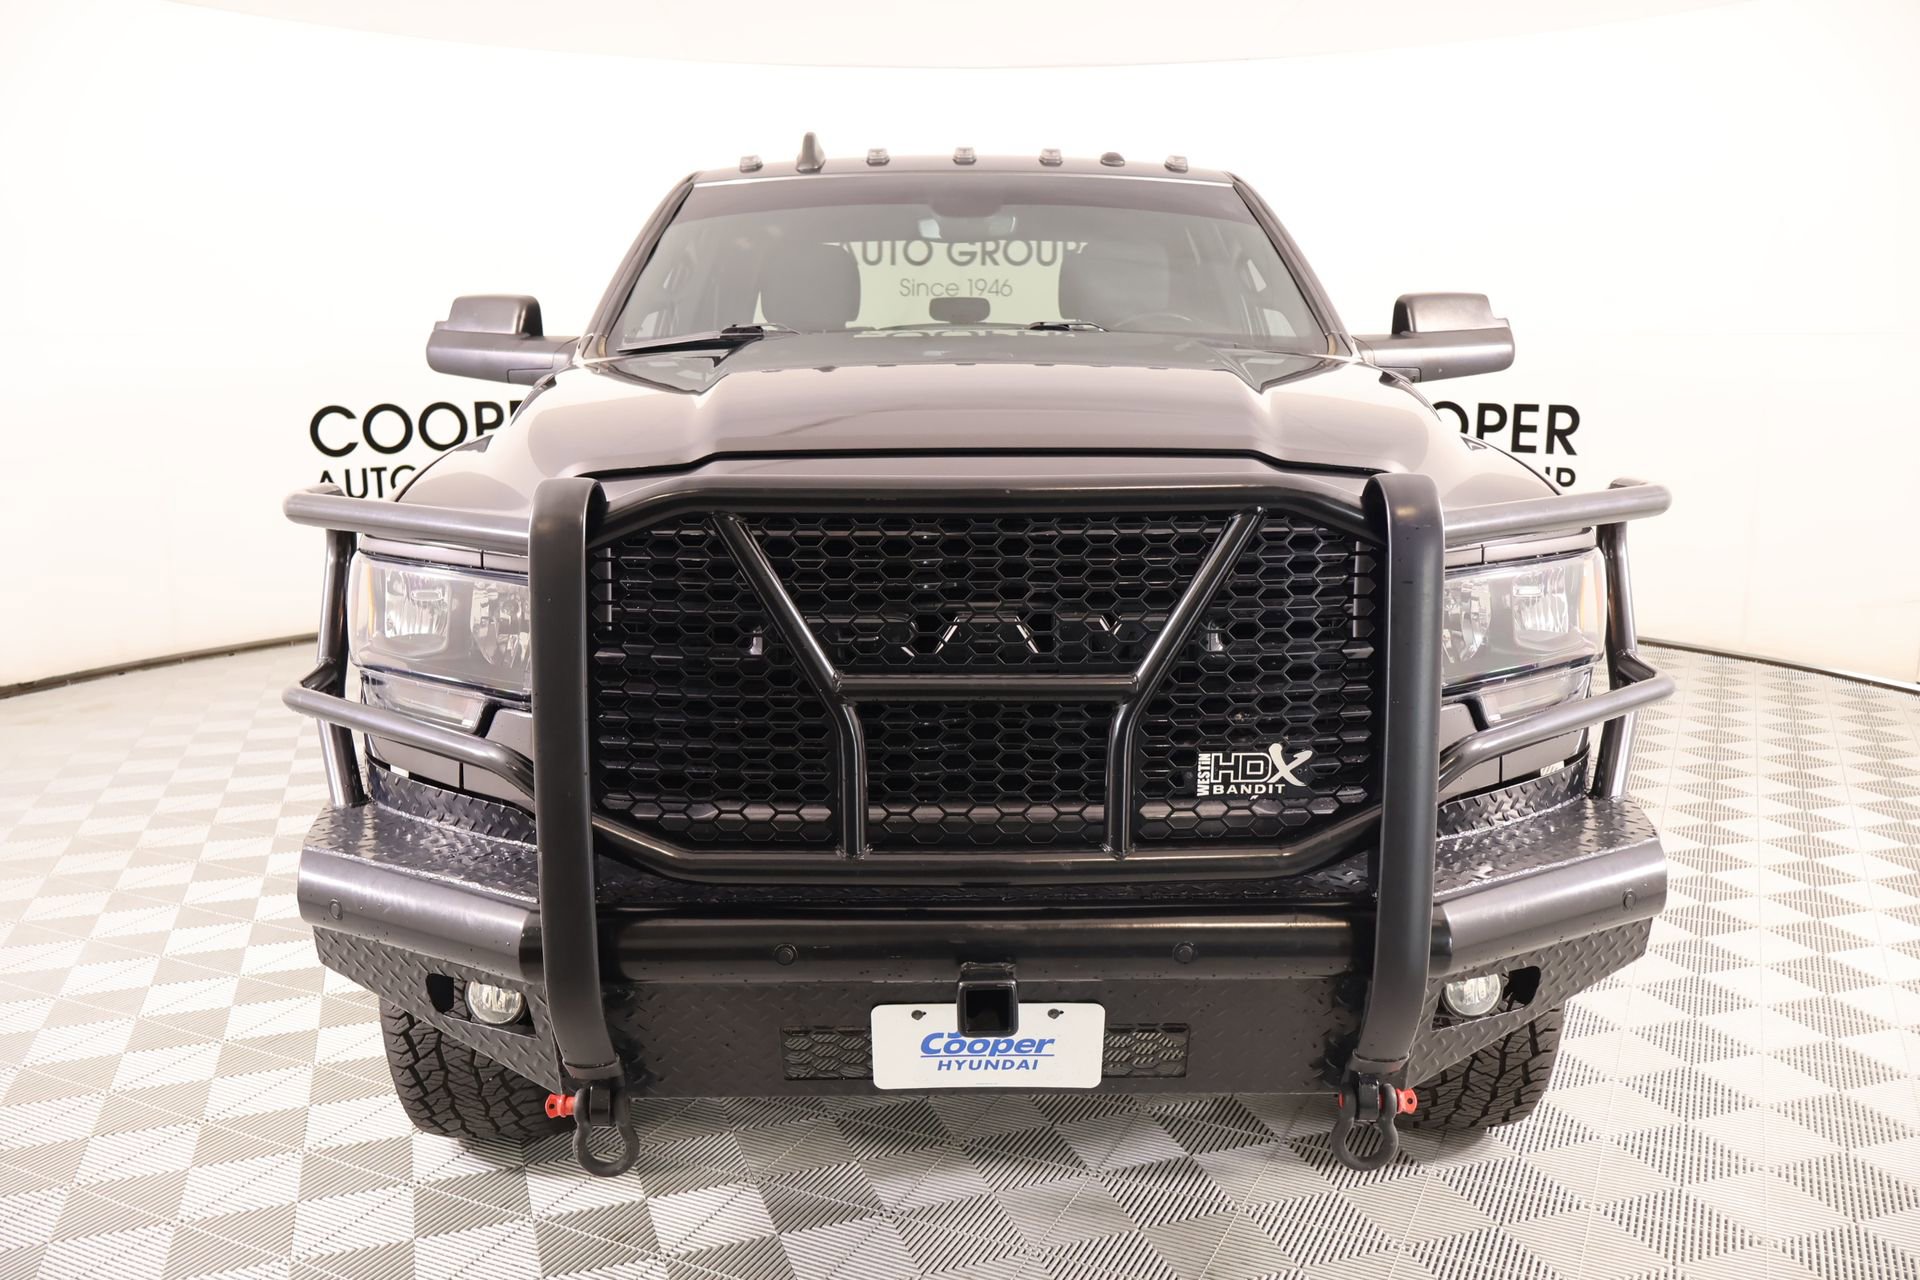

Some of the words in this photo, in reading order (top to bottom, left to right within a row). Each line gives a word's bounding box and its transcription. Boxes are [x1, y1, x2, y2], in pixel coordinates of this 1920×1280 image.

[900, 278, 959, 297] Since
[967, 278, 1013, 297] 1946
[1211, 743, 1313, 786] HDX
[1212, 784, 1286, 795] BANDIT
[920, 1031, 1056, 1057] Cooper
[937, 1059, 1039, 1071] HYUNDAI
